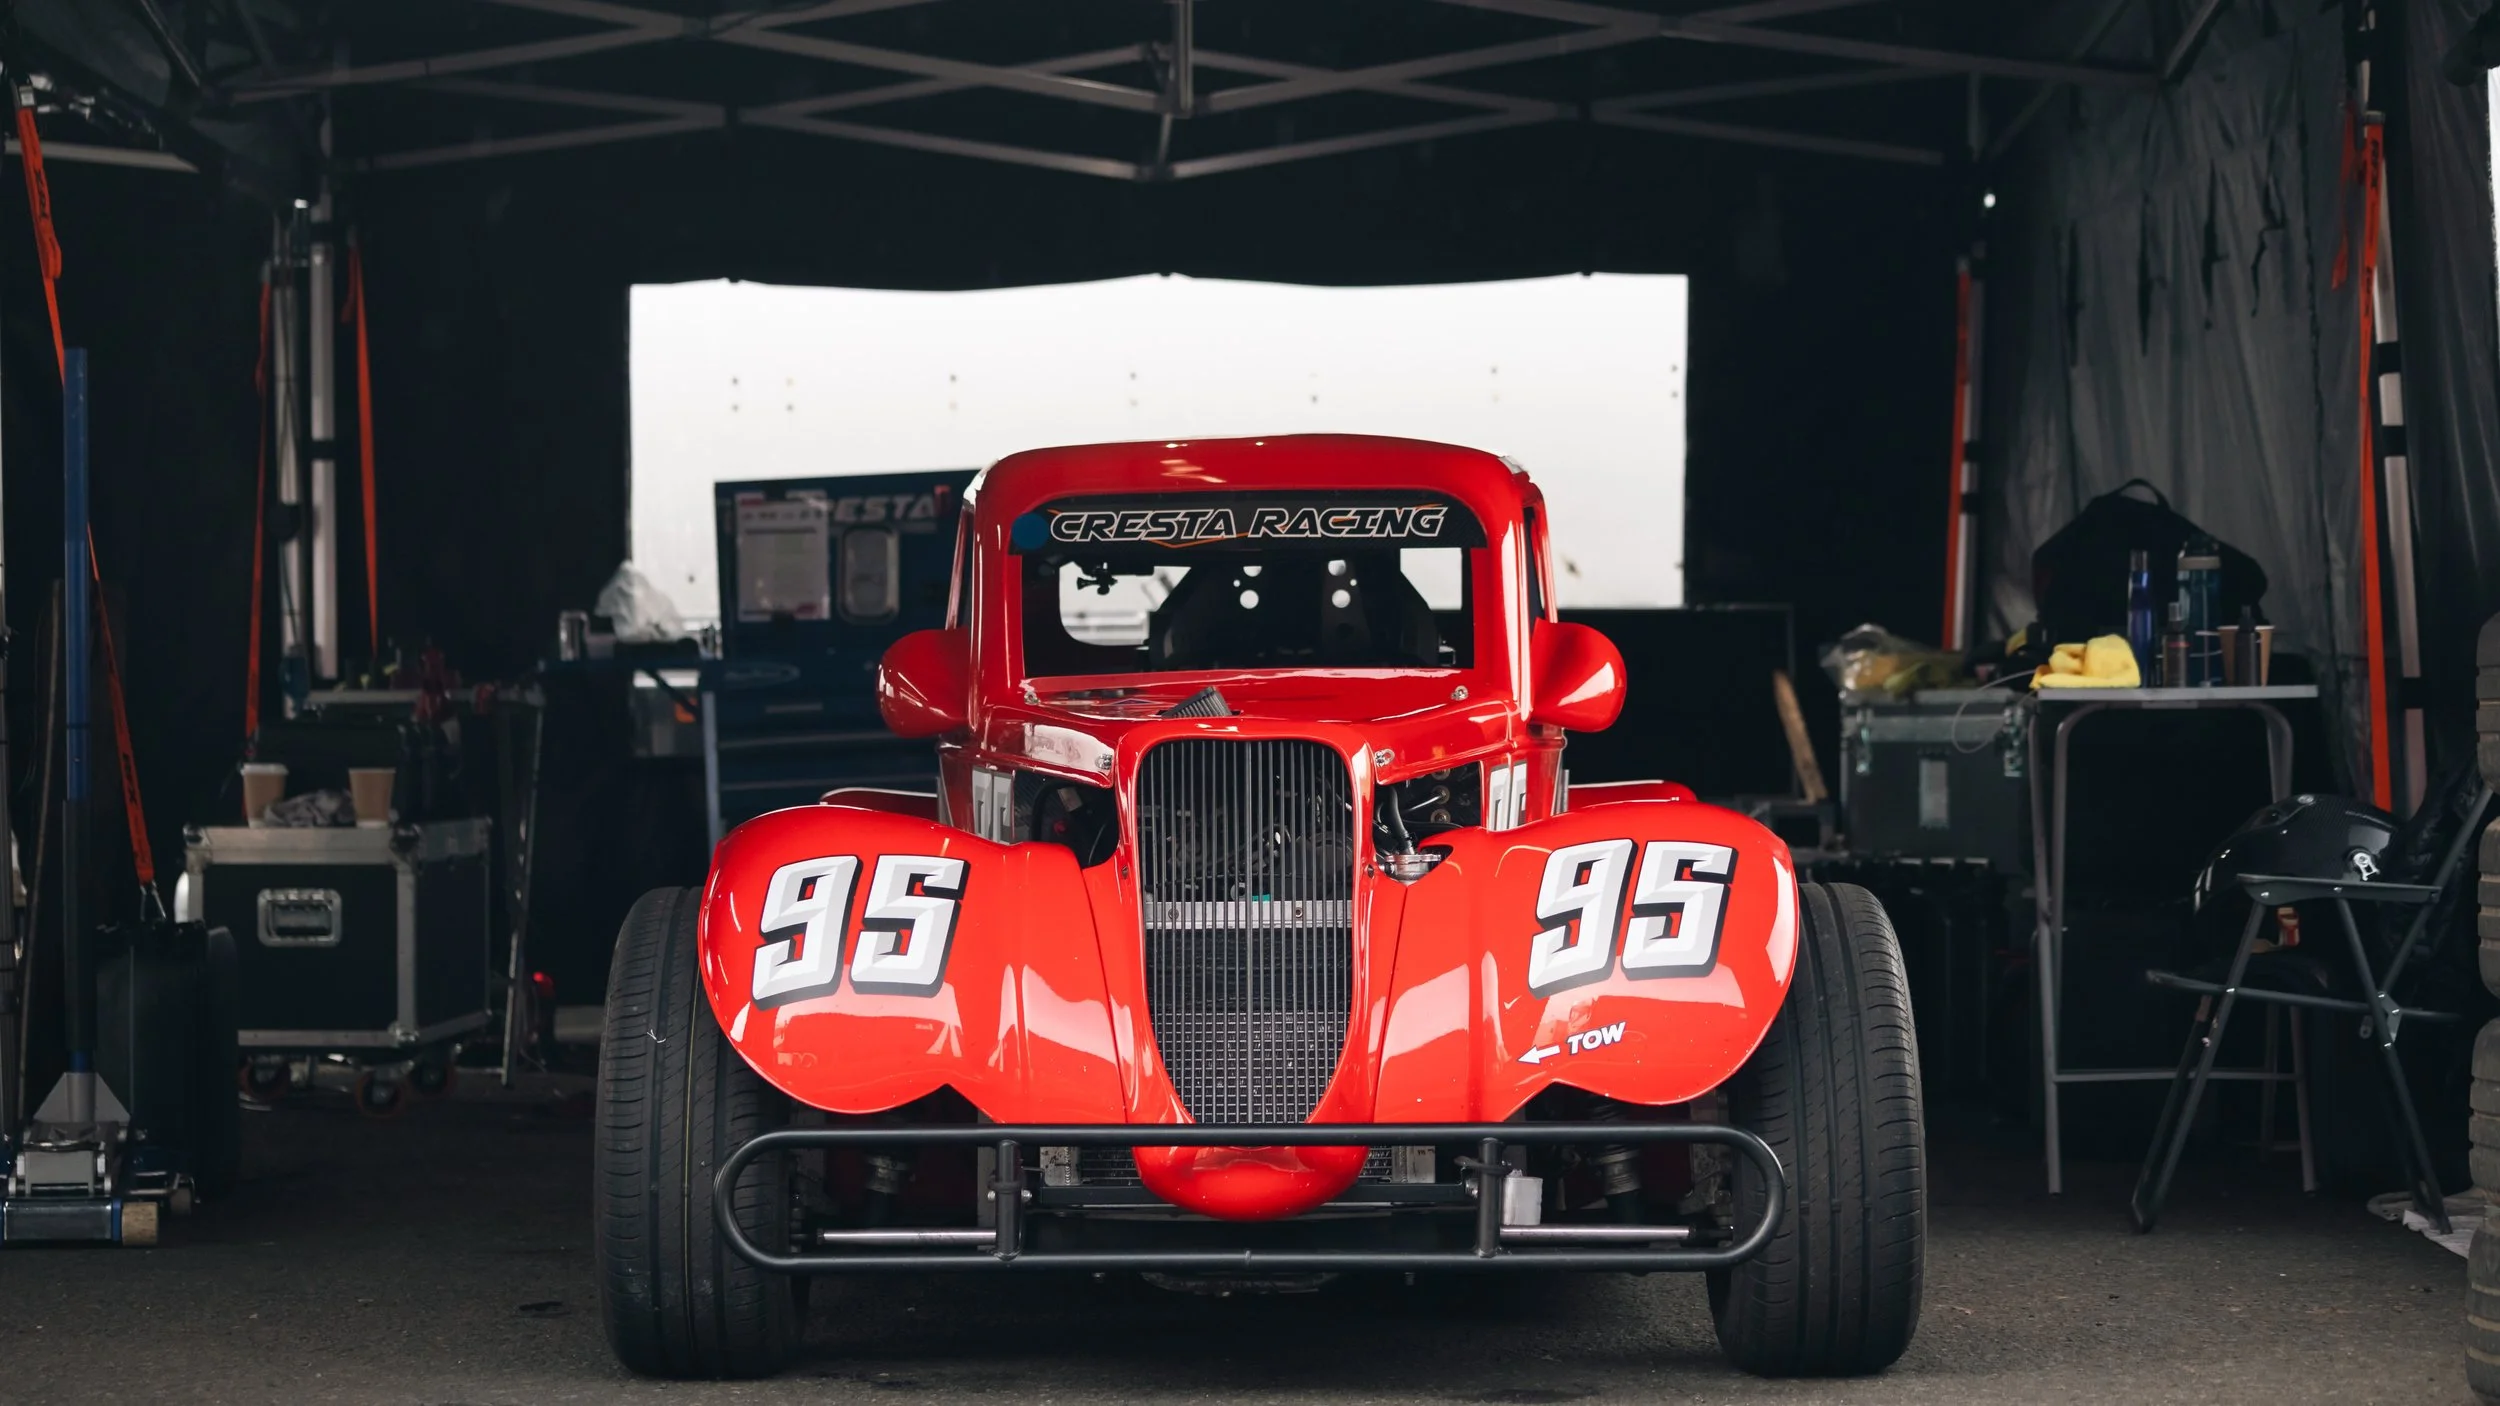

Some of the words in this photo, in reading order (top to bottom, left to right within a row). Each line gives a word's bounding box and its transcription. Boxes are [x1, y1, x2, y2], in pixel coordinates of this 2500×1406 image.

[826, 495, 936, 523] ESTA
[1050, 508, 1237, 542] CRESTA
[1248, 506, 1449, 538] RACING
[752, 855, 971, 1011] 95
[1528, 838, 1739, 1000] 95
[1567, 1022, 1627, 1055] TOW
